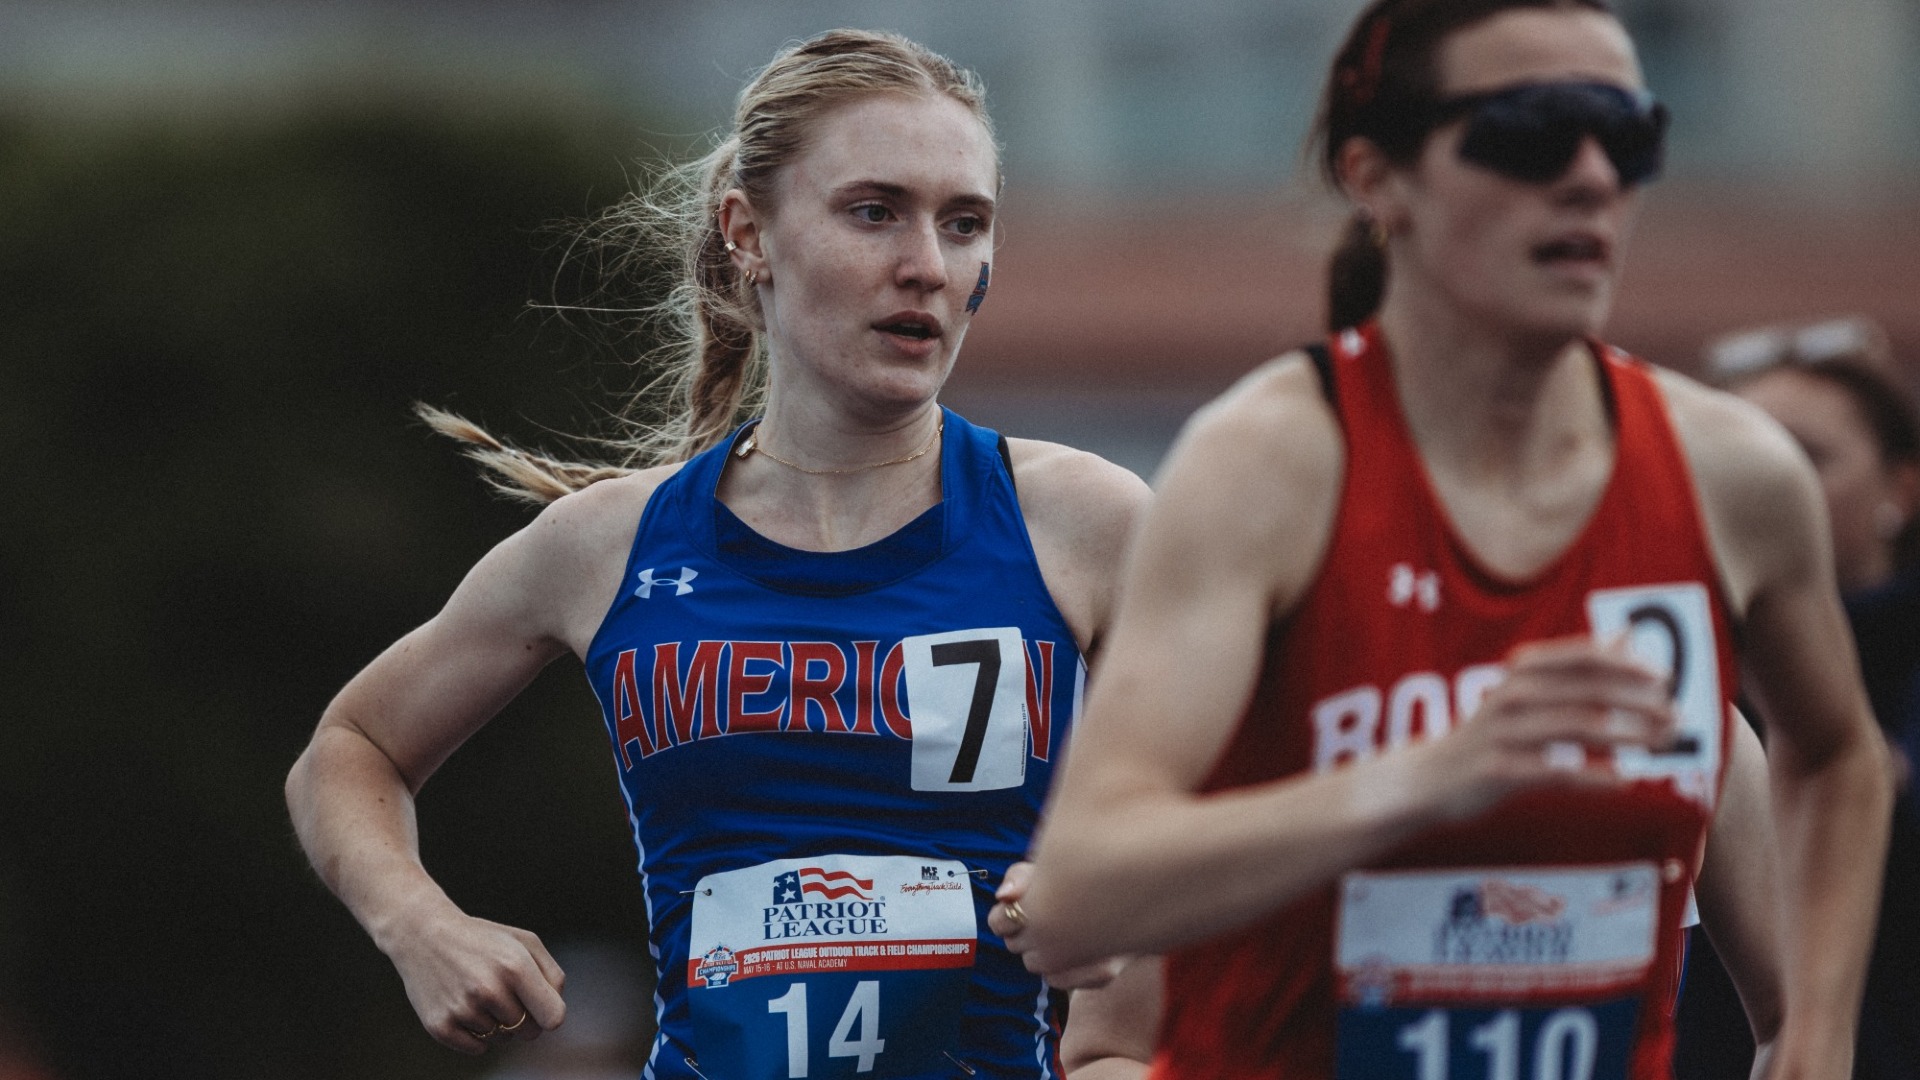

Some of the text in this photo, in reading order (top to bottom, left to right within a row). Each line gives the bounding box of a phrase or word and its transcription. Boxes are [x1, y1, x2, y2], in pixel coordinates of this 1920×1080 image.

[613, 639, 1056, 773] AMERICN
[930, 638, 1002, 784] 7
[762, 901, 886, 924] PATRIOT
[762, 918, 889, 940] LEAGUE
[744, 966, 754, 974] MAY
[776, 962, 783, 970] AT
[784, 960, 796, 970] U.S.
[797, 959, 817, 969] NAVAL
[818, 958, 847, 968] ACADEMY
[761, 949, 790, 961] PATRIOT
[791, 947, 818, 959] LEAGUE
[819, 946, 853, 957] OUTDOOR
[854, 945, 878, 956] TRACK
[880, 945, 886, 955] &
[887, 945, 905, 955] FIELD
[907, 944, 969, 955] CHAMPIONSHIPS
[768, 980, 886, 1079] 14
[1397, 1006, 1601, 1080] 110
